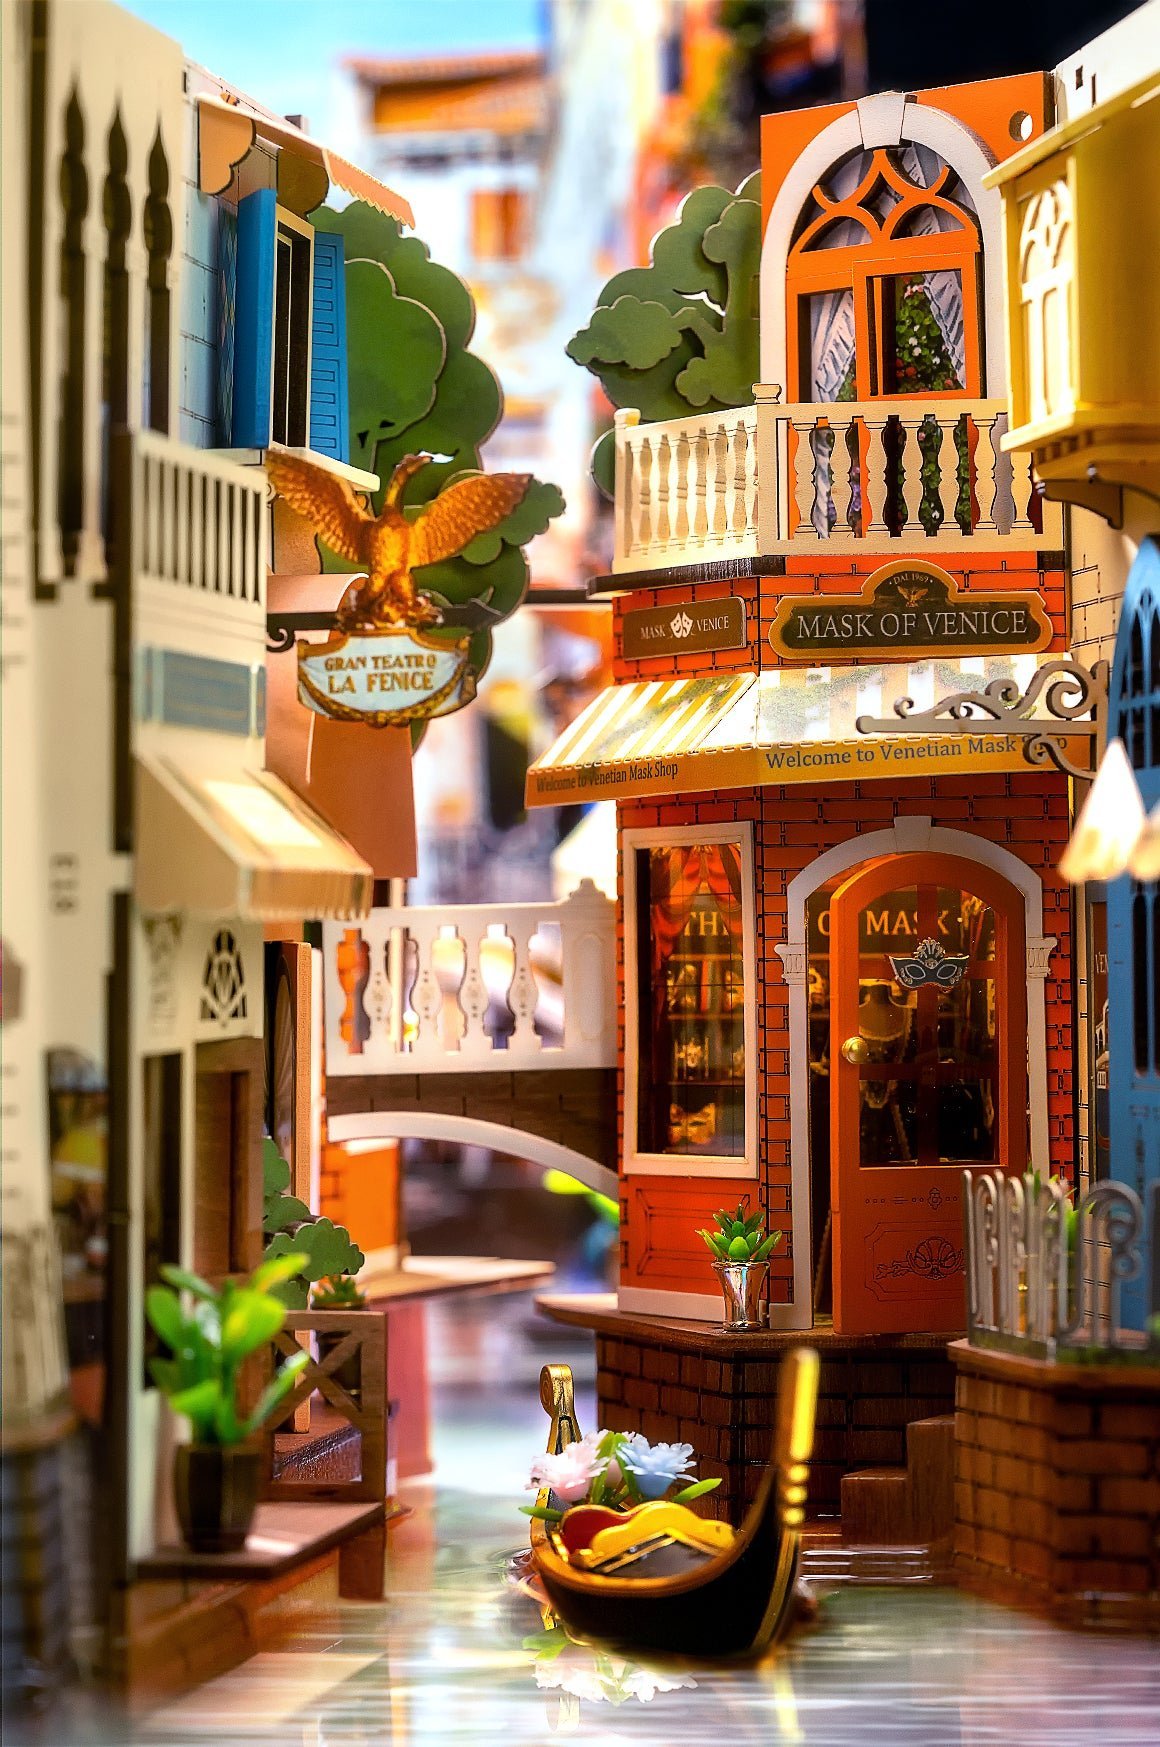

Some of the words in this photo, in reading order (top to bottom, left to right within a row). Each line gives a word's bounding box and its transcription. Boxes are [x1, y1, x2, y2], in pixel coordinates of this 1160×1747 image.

[640, 624, 666, 640] MASK
[697, 615, 730, 632] VENICE
[797, 613, 875, 639] MASK
[880, 612, 918, 637] OF
[923, 610, 1028, 636] VENICE
[324, 656, 368, 672] GRAN
[370, 653, 437, 670] TEATRO
[328, 675, 356, 694] LA
[366, 671, 434, 692] FENICE
[765, 751, 852, 769] Welcome
[856, 748, 875, 762] to
[880, 741, 962, 761] Venetian
[968, 736, 1017, 754] Mask
[536, 775, 576, 793] Welcome
[578, 773, 587, 788] to
[589, 768, 627, 787] Venetian
[629, 761, 653, 781] Mask
[654, 760, 678, 780] Shop
[866, 910, 950, 936] MAK
